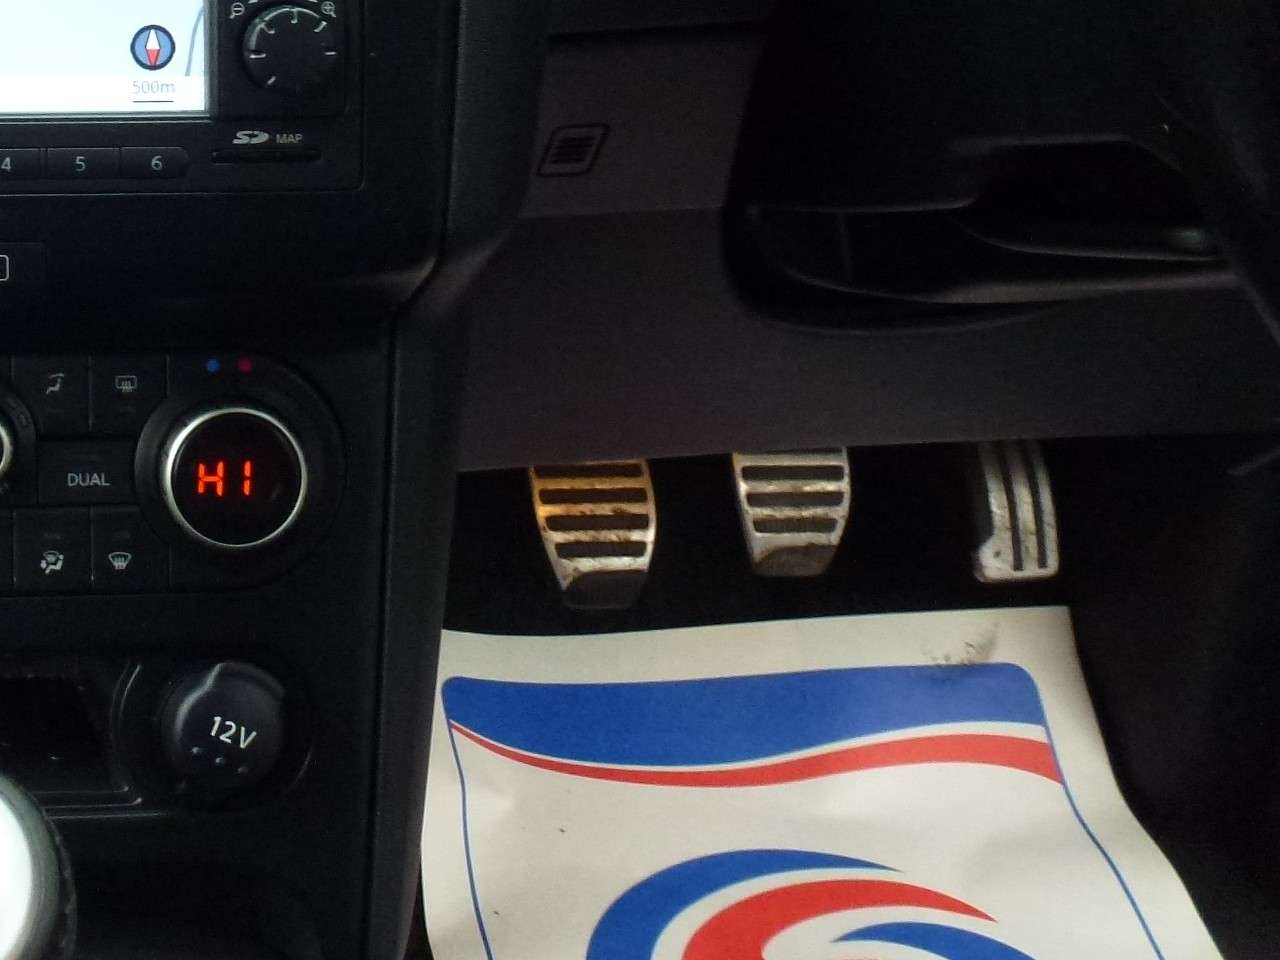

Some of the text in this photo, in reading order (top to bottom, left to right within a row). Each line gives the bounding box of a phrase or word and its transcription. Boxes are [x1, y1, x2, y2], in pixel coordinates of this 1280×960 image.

[131, 80, 176, 95] 500m
[275, 134, 303, 144] MAP
[0, 156, 12, 172] 4
[75, 156, 86, 172] 5
[151, 156, 163, 171] 6
[66, 472, 111, 487] DUAL
[209, 715, 257, 751] 12V
